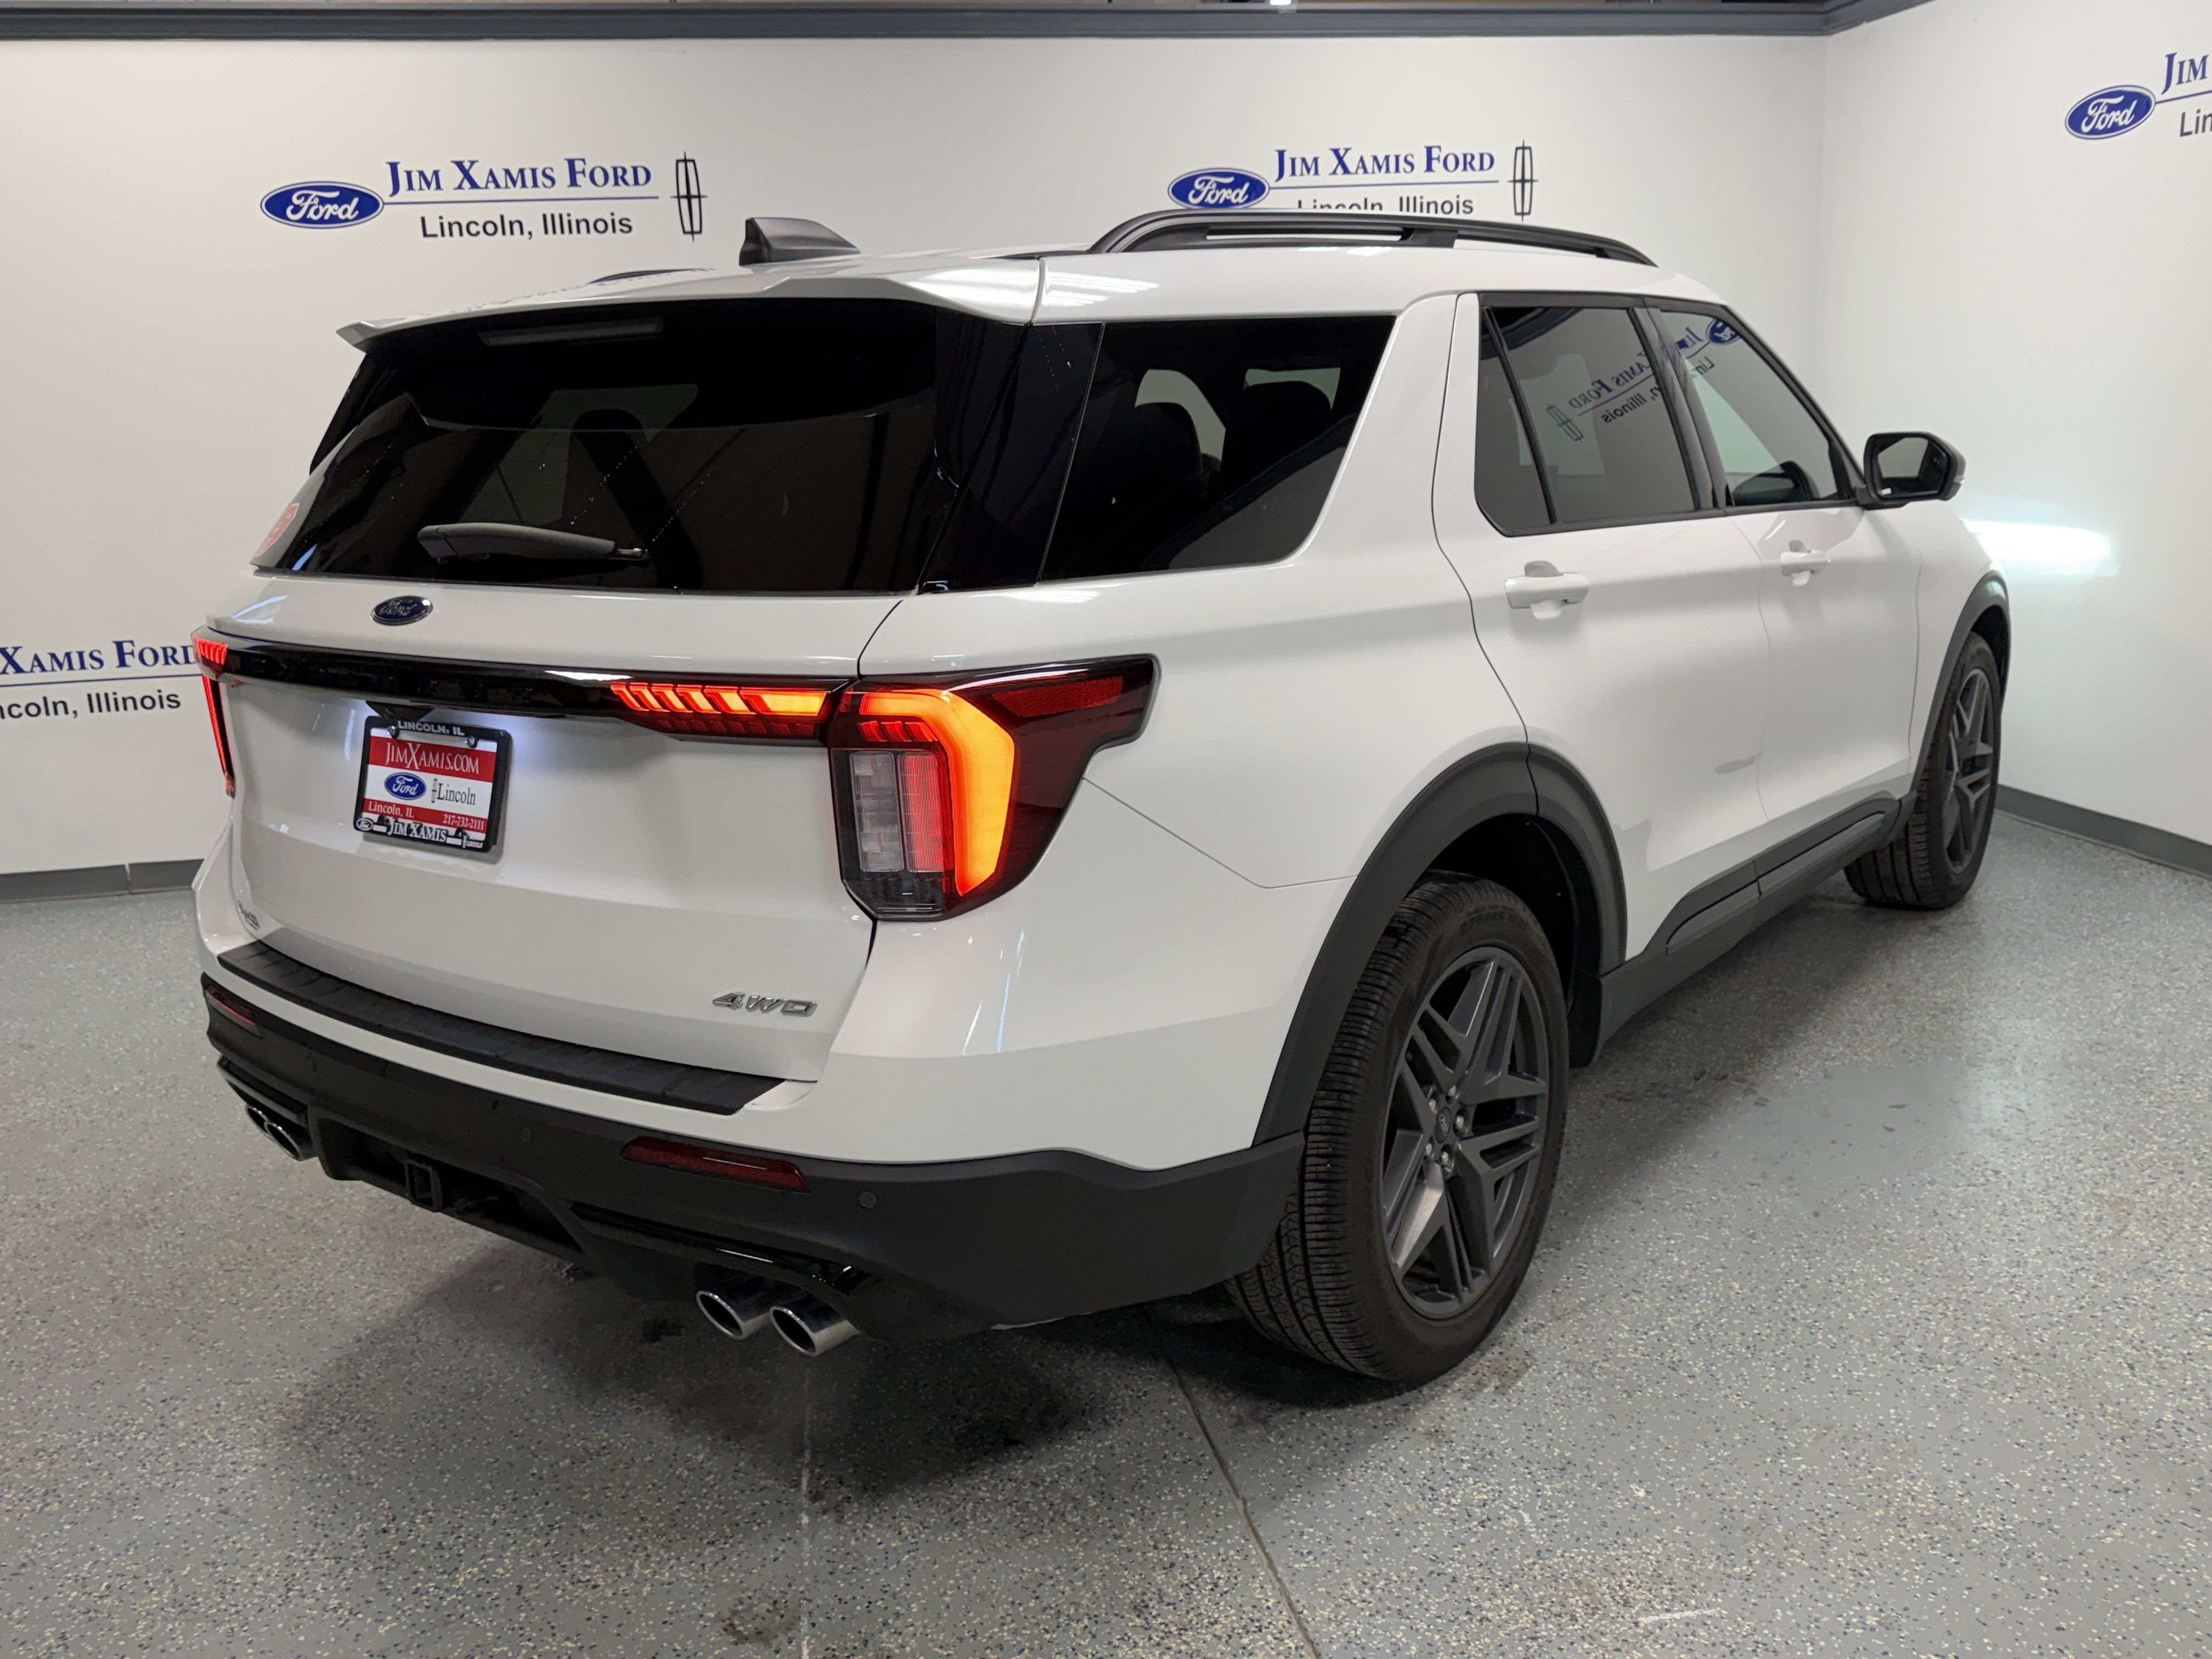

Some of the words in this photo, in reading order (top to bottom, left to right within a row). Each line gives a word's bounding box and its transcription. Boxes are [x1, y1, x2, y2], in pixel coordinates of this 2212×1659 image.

[2161, 52, 2209, 95] JIM
[2081, 95, 2138, 133] Ford
[386, 161, 443, 197] JIM
[450, 159, 556, 190] XAMIS
[564, 158, 651, 188] FORD
[1274, 149, 1319, 183] JIM
[1328, 148, 1415, 176] XAMIS
[1423, 145, 1495, 172] FORD
[1188, 176, 1249, 205] Ford
[286, 191, 359, 221] Ford
[1400, 194, 1474, 215] Illinois
[421, 215, 533, 239] Lincoln,
[543, 212, 633, 235] Illinois
[0, 646, 104, 674] XAMIS
[87, 690, 181, 713] Illinois
[398, 721, 449, 733] LINCOLN,
[453, 726, 465, 736] IL
[386, 742, 479, 774] JIMXAMIS.COM
[392, 776, 417, 795] Ford
[437, 783, 476, 805] Lincoln
[405, 809, 414, 818] IL
[387, 818, 408, 836] JIM
[409, 823, 447, 843] XAMIS
[712, 992, 817, 1017] 4WD
